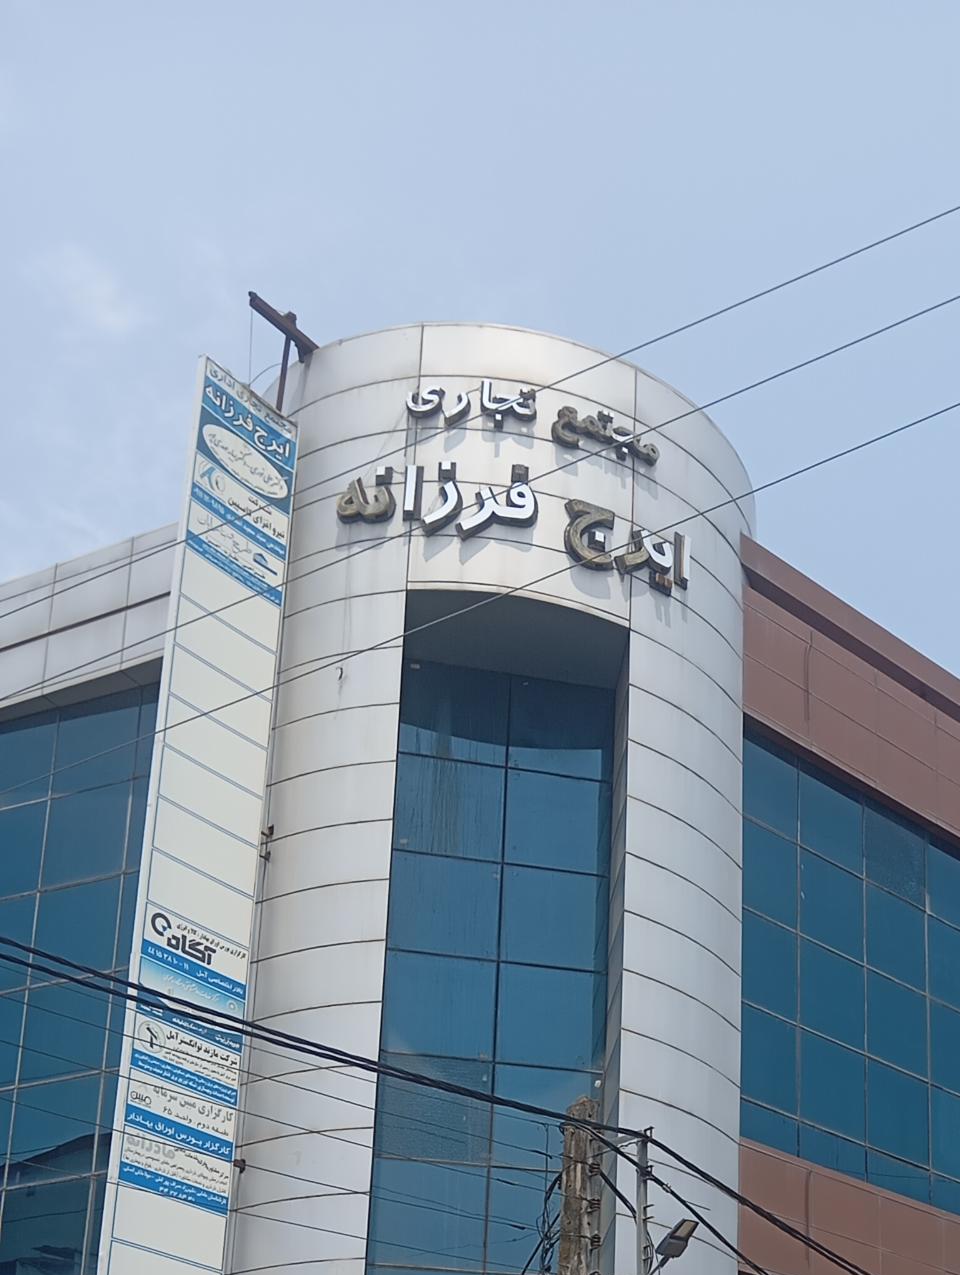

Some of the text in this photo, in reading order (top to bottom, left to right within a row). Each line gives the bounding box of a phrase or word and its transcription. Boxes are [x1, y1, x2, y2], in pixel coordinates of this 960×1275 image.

[205, 386, 290, 459] ایرج فرزانه
[406, 379, 660, 466] مجتمع تجاری
[336, 461, 539, 540] فرزانه
[564, 499, 692, 597] ایرج
[166, 934, 217, 965] آگاه
[127, 1112, 231, 1154] کارگزار بورس اوراق بهادار
